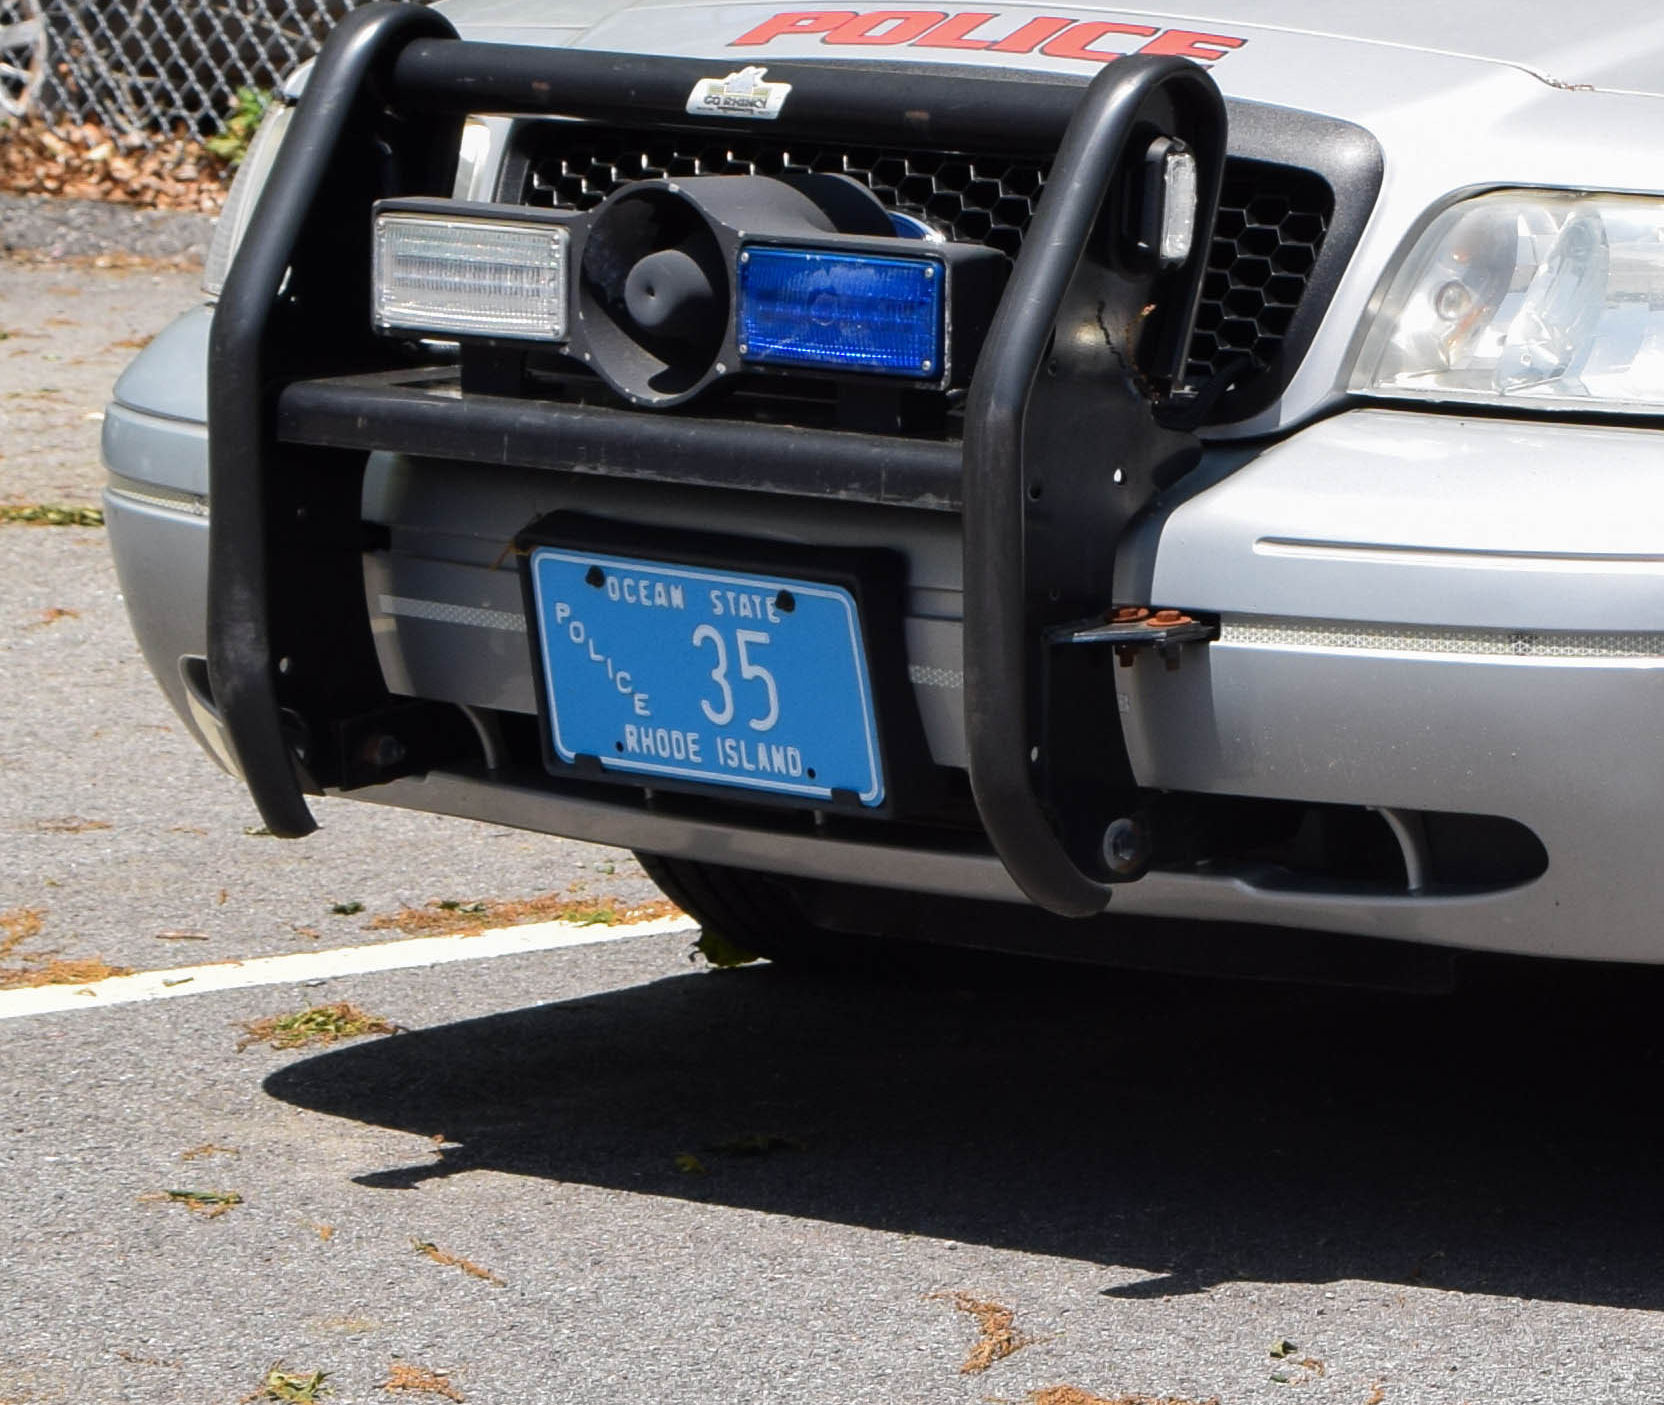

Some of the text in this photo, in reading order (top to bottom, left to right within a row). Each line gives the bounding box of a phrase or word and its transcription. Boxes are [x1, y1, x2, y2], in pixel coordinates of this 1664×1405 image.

[725, 9, 1249, 71] POLICE
[606, 576, 781, 624] OCEAN STATE
[554, 602, 651, 717] POLICE
[692, 624, 780, 732] 35
[624, 724, 802, 777] RHODE ISLAND
